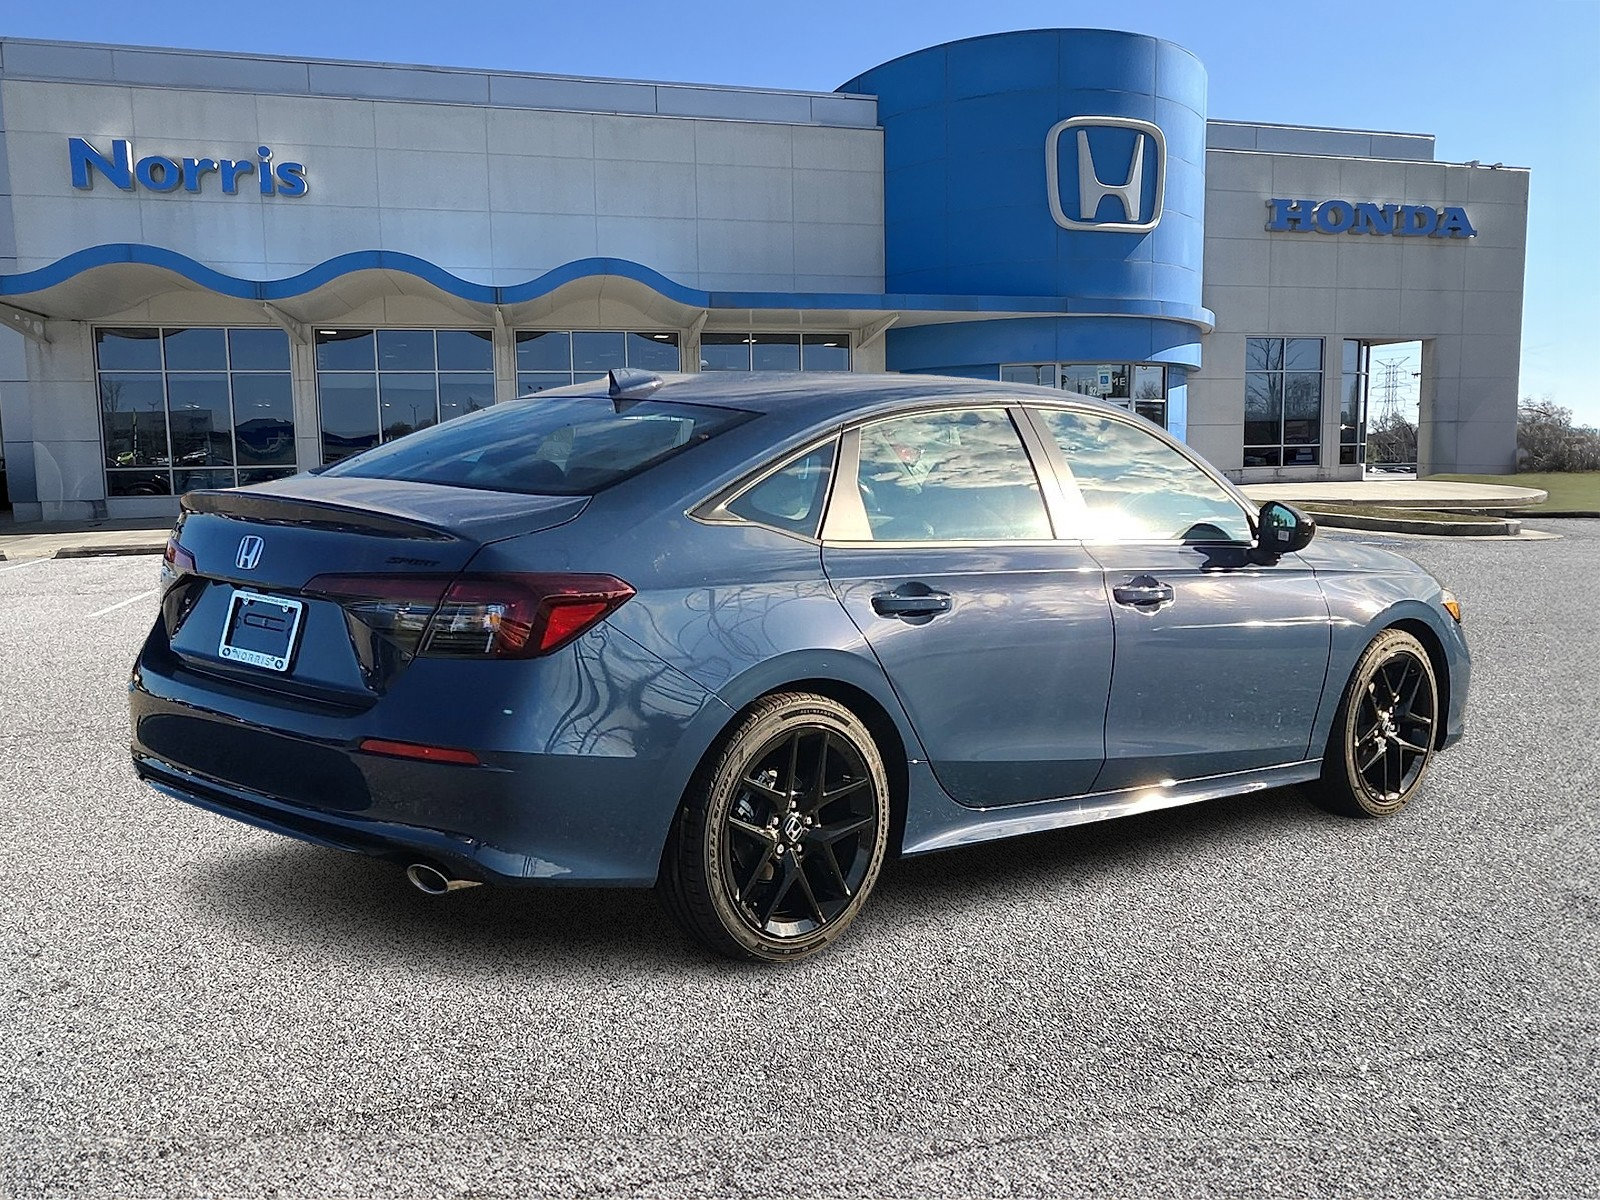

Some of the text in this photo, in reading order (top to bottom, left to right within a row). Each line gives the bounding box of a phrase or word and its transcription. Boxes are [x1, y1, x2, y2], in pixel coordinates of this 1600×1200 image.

[68, 137, 309, 197] Norris
[1266, 198, 1478, 238] HONDA
[231, 648, 271, 667] NORRIS
